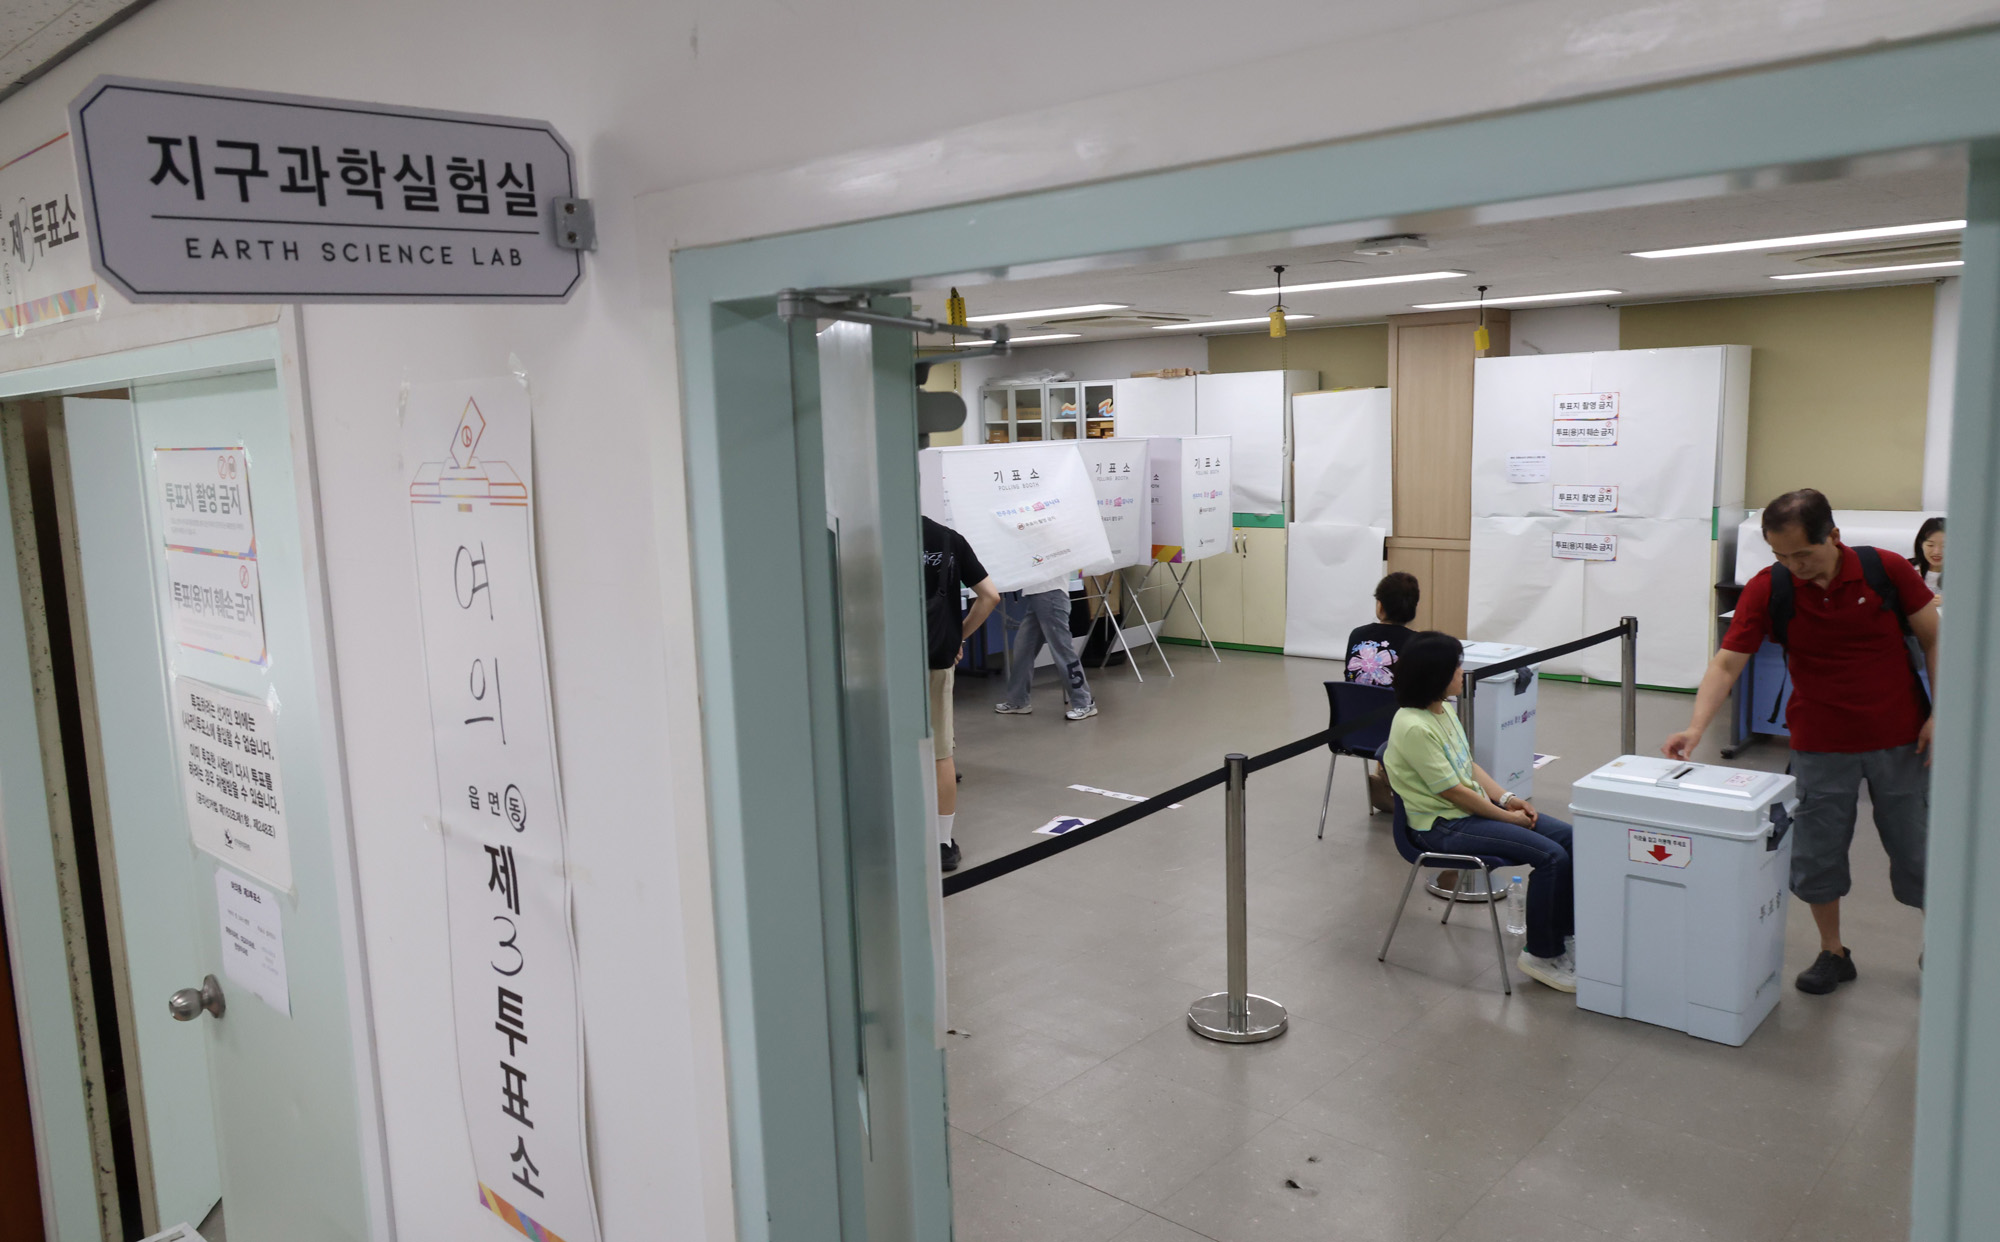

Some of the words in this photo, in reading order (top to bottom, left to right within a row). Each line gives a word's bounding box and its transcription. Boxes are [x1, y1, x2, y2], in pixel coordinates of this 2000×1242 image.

[146, 134, 539, 218] 지구과학실험실
[186, 237, 300, 260] EARTH
[322, 242, 454, 266] SCIENCE
[472, 247, 524, 267] LAB
[1559, 402, 1579, 410] 투표지
[1582, 401, 1596, 410] 촬영
[1598, 401, 1613, 409] 금지
[1556, 428, 1585, 437] 투표(용)지
[1600, 428, 1614, 436] 금지
[993, 468, 1040, 484] 기표소
[1095, 462, 1130, 474] 기표소
[219, 484, 242, 515] 금지
[1558, 493, 1580, 502] 투표지
[1582, 493, 1596, 502] 촬영
[1597, 494, 1612, 502] 금지
[1555, 541, 1584, 550] 투표(용)지
[1599, 542, 1613, 552] 금지
[235, 592, 256, 624] 금지
[234, 731, 241, 750] 수
[242, 734, 275, 761] 없습니다.
[235, 763, 251, 783] 다시
[251, 768, 273, 791] 투표를
[241, 784, 248, 802] 수
[249, 787, 280, 815] 있습니다.
